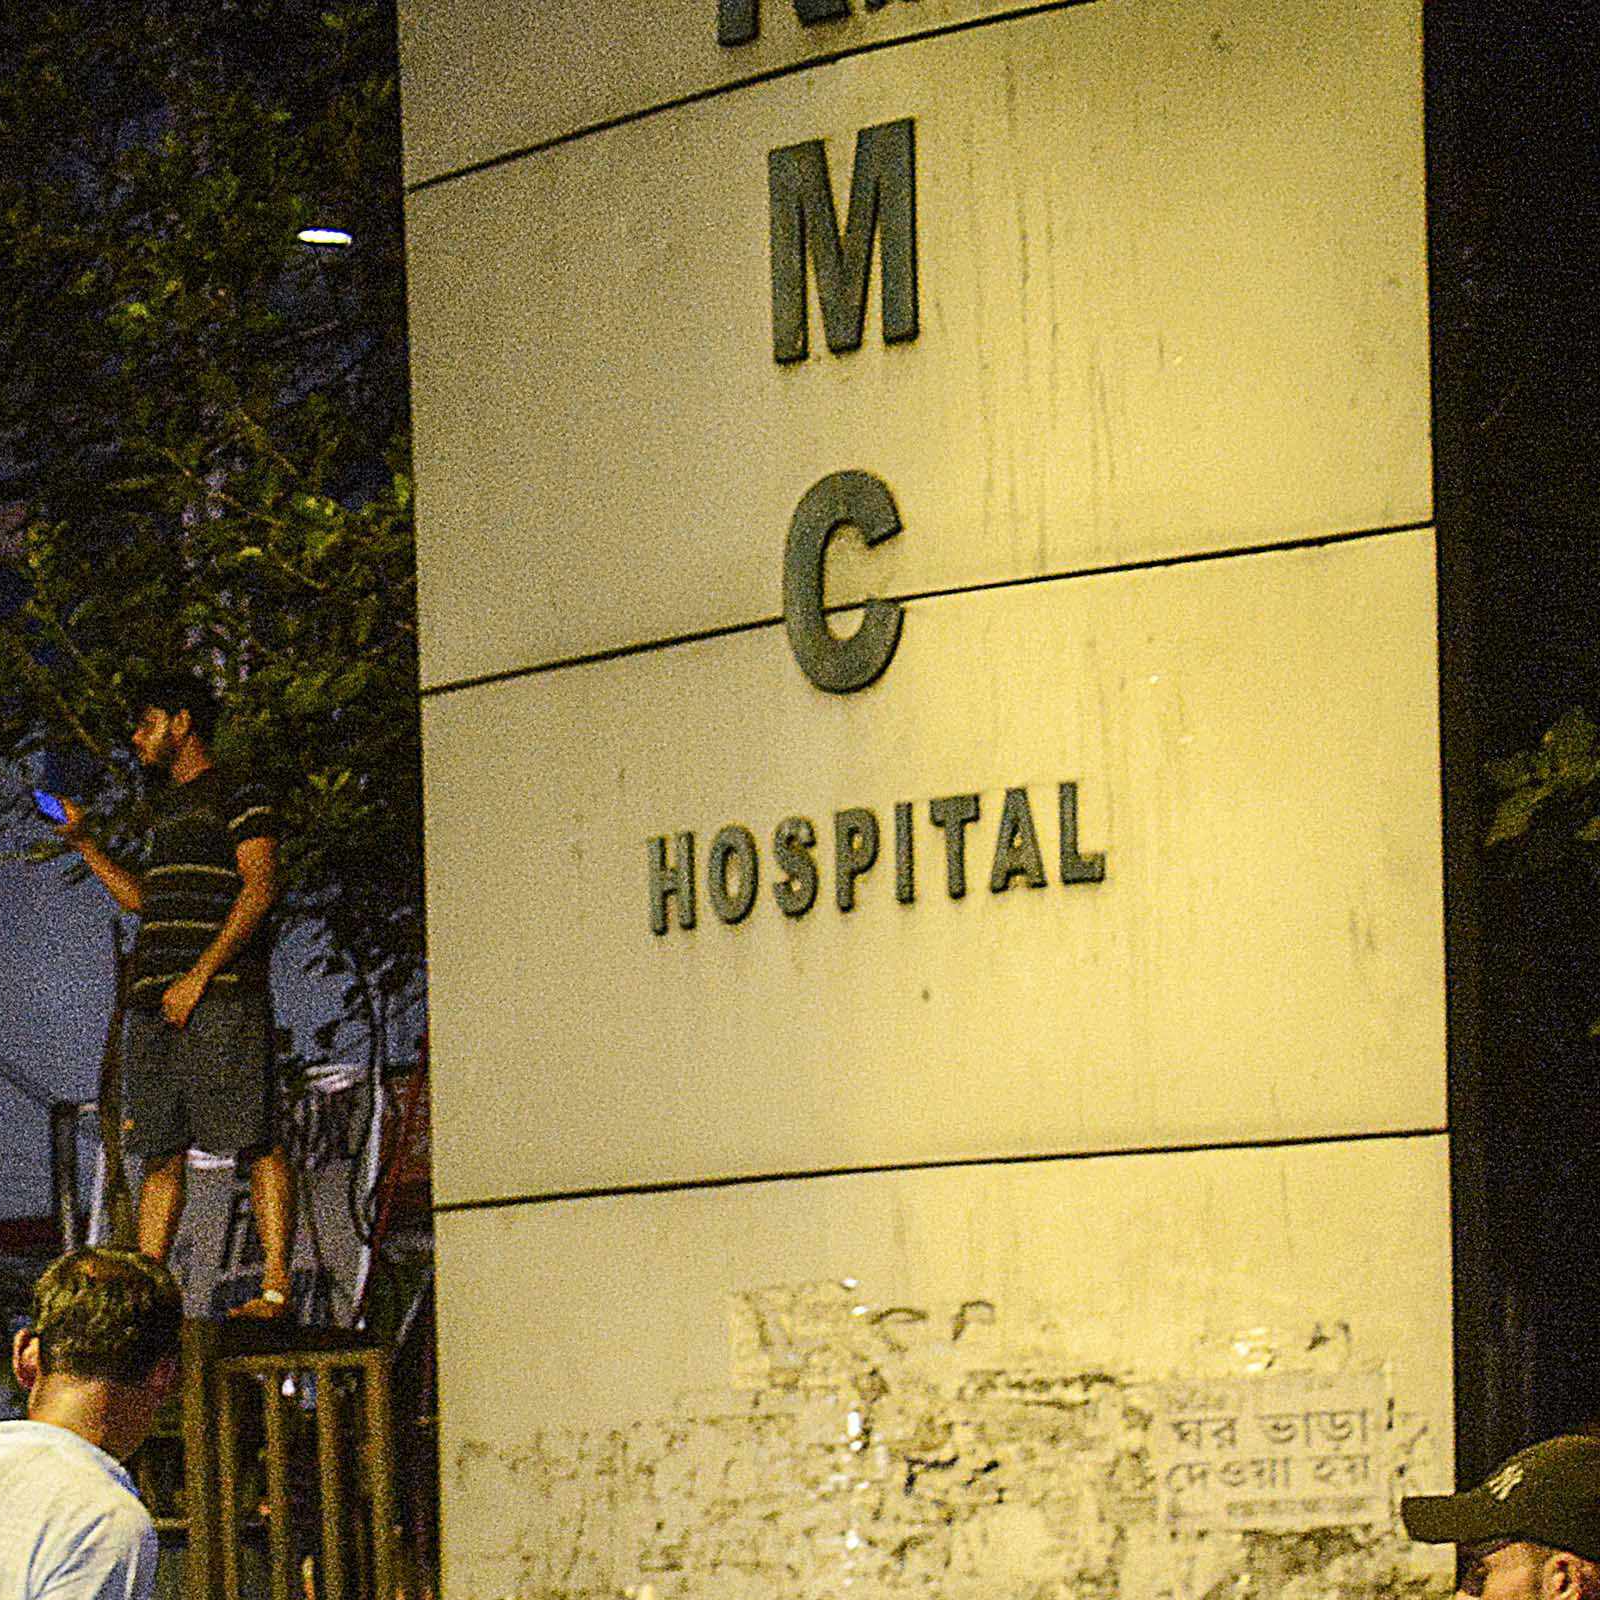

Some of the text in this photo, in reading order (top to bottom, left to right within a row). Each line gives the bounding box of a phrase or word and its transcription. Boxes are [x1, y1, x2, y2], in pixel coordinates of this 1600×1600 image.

[769, 118, 920, 364] M
[782, 470, 906, 694] C
[647, 782, 1107, 936] HOSPITAL
